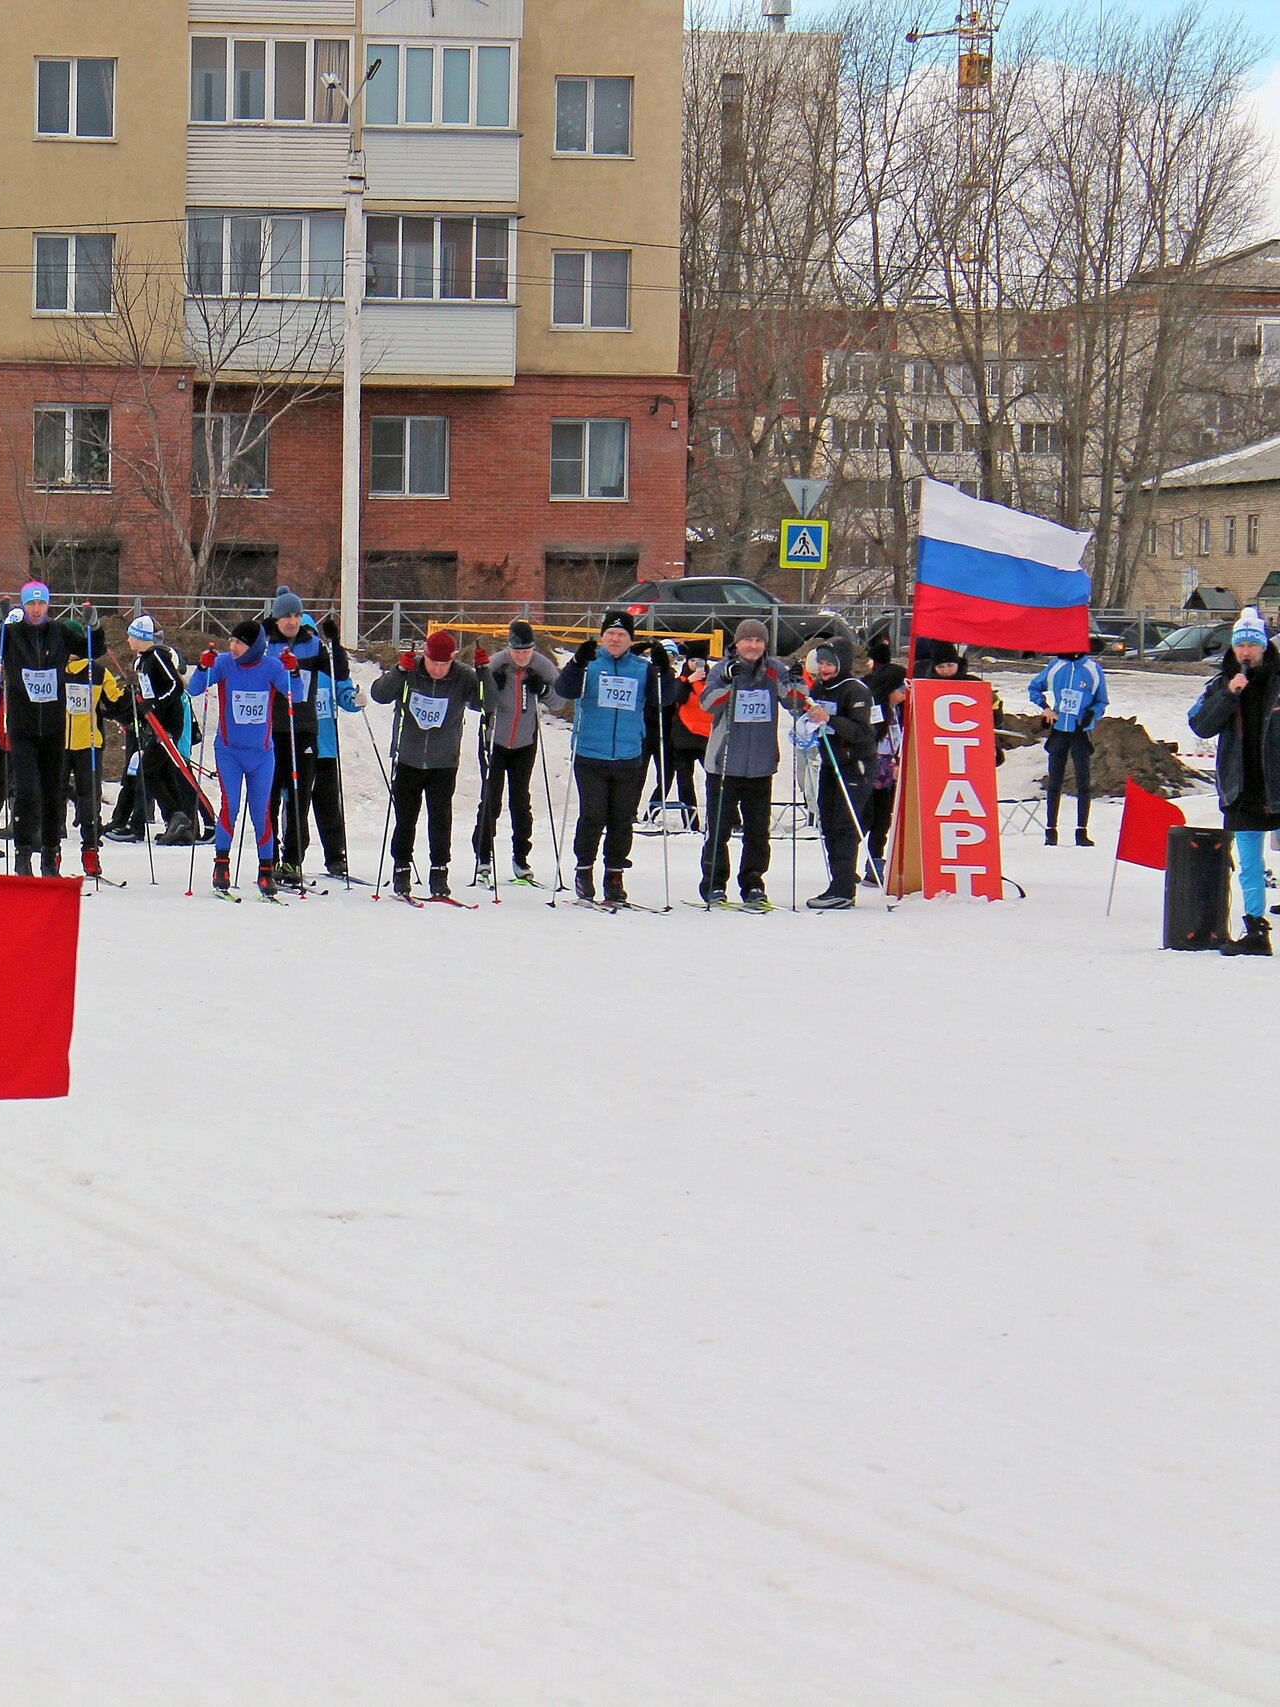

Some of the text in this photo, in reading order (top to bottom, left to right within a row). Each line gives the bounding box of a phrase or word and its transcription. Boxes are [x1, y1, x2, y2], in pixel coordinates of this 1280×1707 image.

[28, 682, 52, 695] 7940
[606, 688, 632, 701] 7927
[239, 704, 264, 717] 7962
[415, 707, 440, 722] 7968
[742, 703, 767, 714] 7972
[933, 694, 987, 897] СТАРТ
